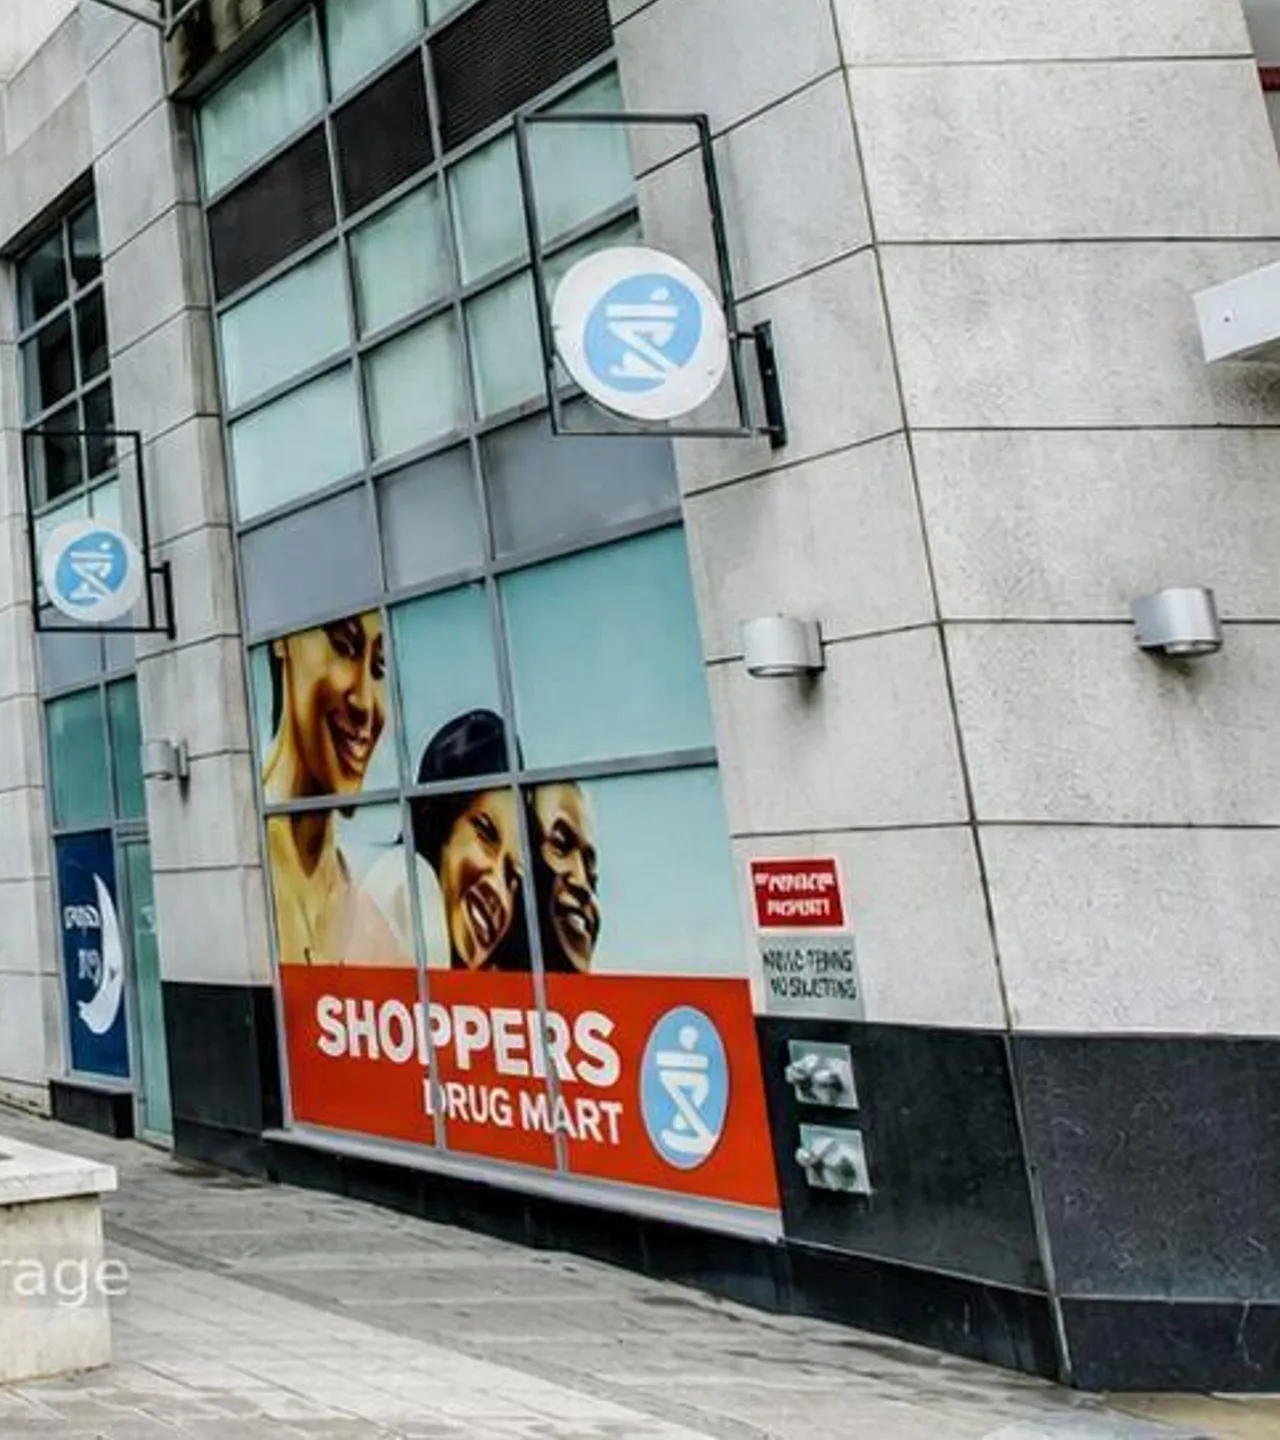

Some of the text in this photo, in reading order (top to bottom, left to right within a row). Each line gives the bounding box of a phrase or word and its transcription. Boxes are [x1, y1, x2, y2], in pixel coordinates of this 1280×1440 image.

[316, 994, 622, 1088] SHOPPERS
[423, 1077, 623, 1146] DRUG MART
